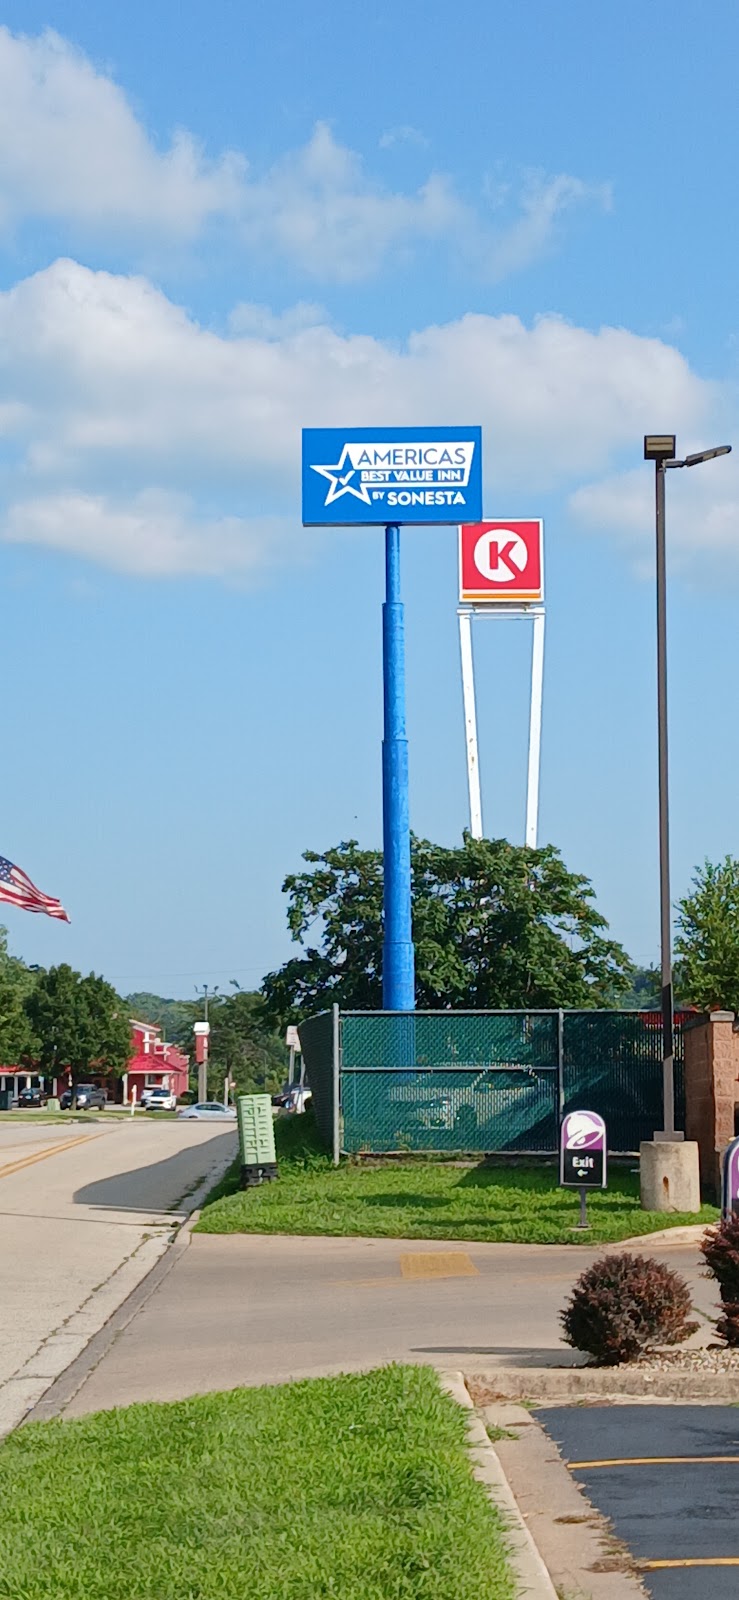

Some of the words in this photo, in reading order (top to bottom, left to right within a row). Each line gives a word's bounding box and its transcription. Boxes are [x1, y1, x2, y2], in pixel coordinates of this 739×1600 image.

[357, 447, 466, 466] AMERICAS
[360, 471, 391, 482] BEST
[393, 470, 433, 482] VALUE
[437, 470, 461, 481] INN
[372, 491, 385, 500] BY
[387, 491, 466, 506] SONESTA
[489, 540, 522, 577] K
[572, 1157, 594, 1168] Exit
